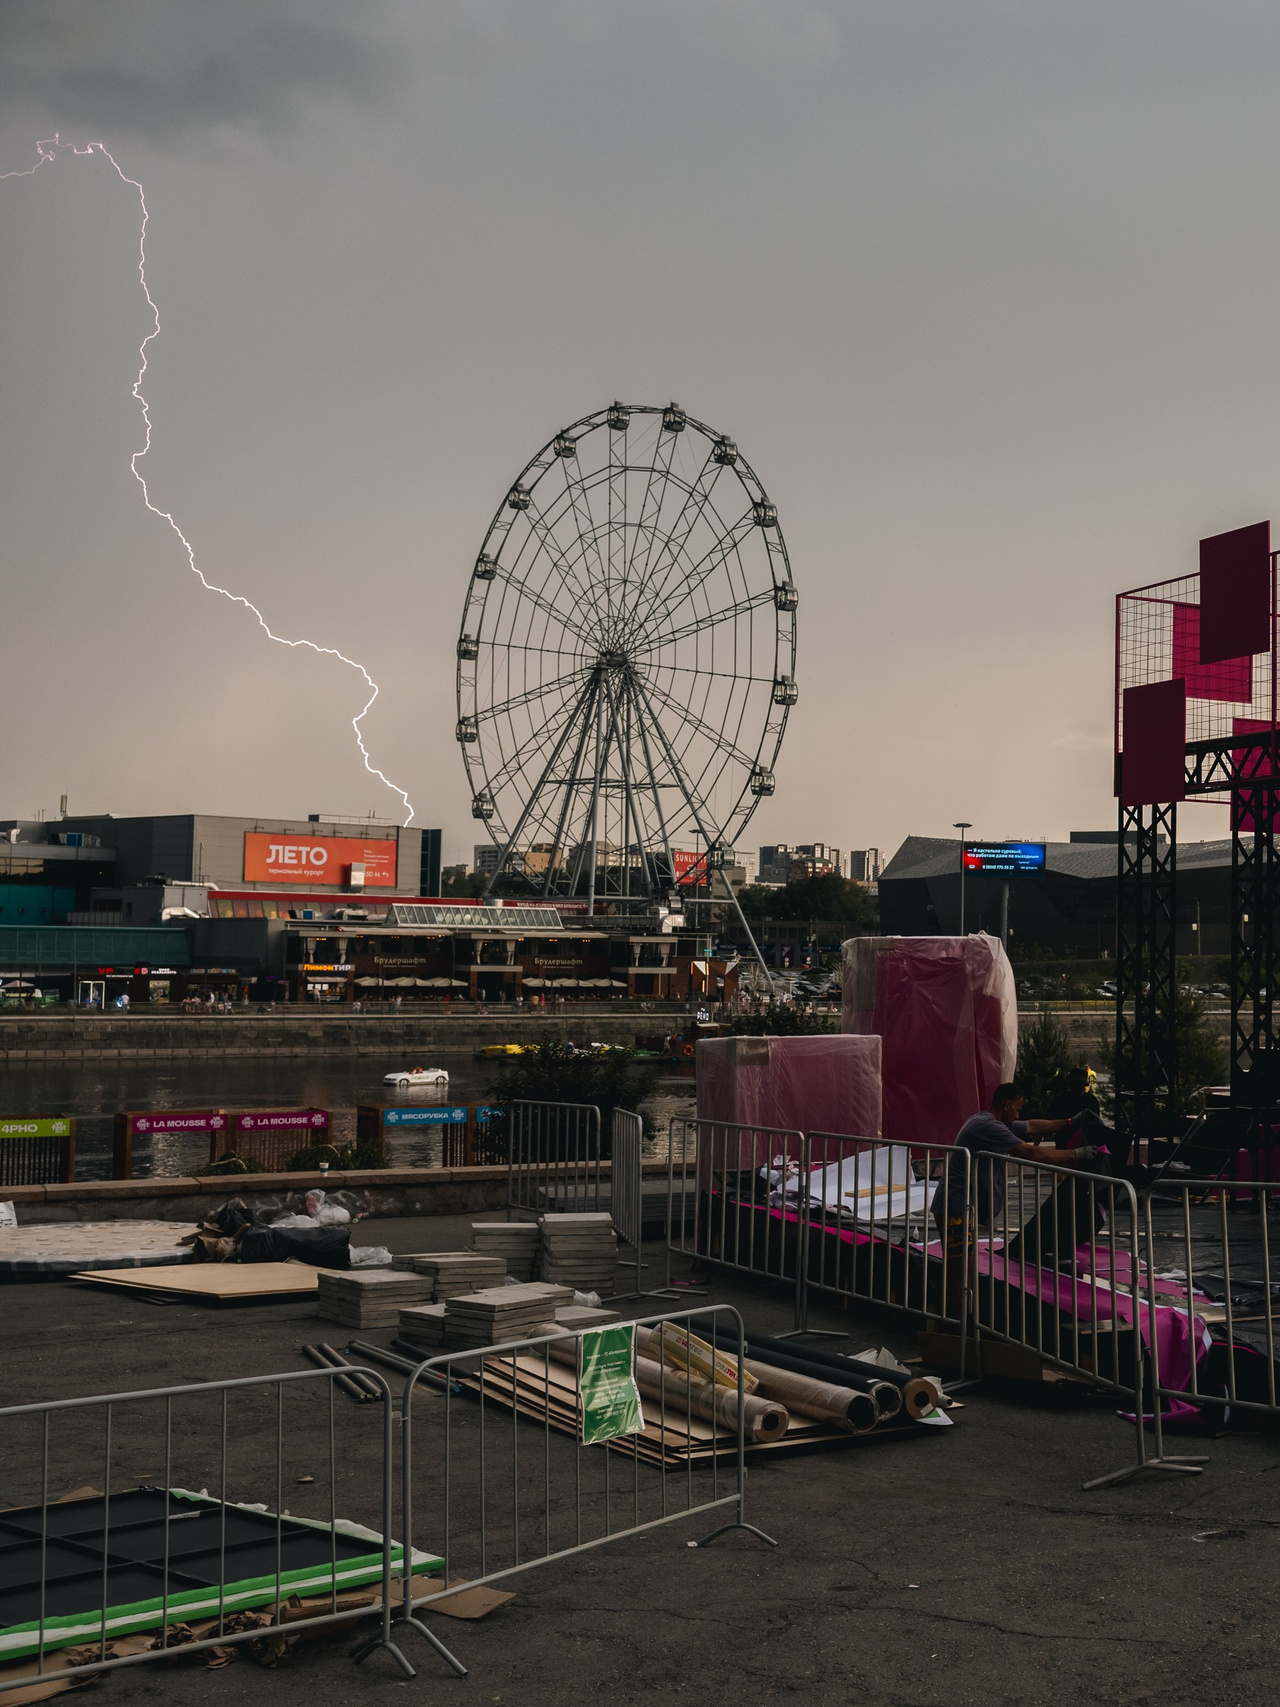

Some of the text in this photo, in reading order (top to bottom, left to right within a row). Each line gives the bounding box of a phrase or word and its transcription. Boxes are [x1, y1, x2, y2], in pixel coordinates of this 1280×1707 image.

[266, 844, 328, 865] ЛЕТО
[268, 867, 324, 877] термальный курорт
[373, 956, 426, 965] Брудершафт
[534, 957, 583, 966] Брудершафт
[402, 1112, 449, 1120] МЯСОРУБКА
[153, 1119, 206, 1128] LA MOUSSE
[270, 1117, 308, 1125] MOUSSE
